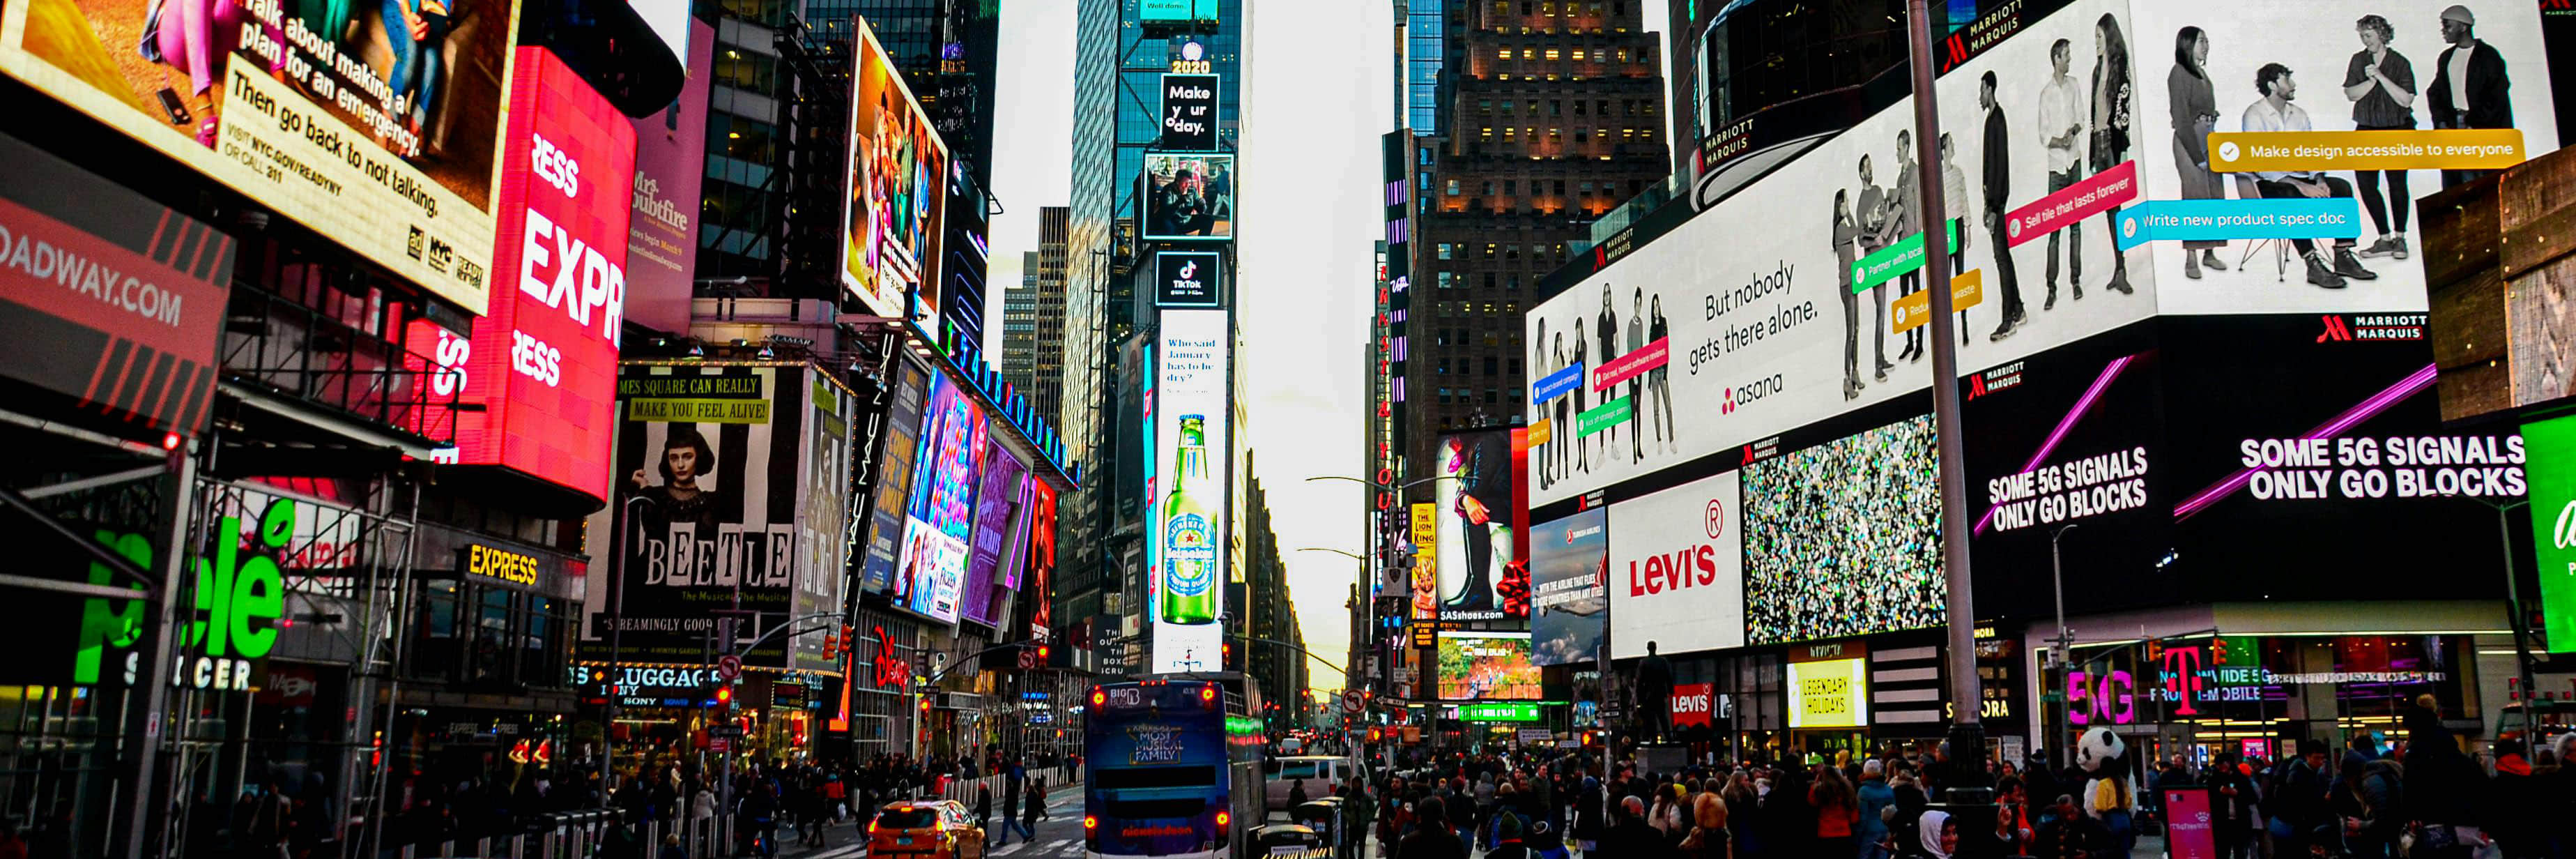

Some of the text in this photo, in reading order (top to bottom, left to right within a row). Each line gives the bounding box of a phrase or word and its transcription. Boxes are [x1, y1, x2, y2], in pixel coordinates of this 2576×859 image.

[1972, 17, 2018, 52] MARQUIS
[285, 17, 406, 115] about making a
[1172, 61, 1211, 74] 2020
[239, 22, 420, 157] plan for an emergency.
[1170, 86, 1210, 99] Make
[233, 70, 438, 217] Then go back to not talking.
[1706, 119, 1754, 151] MARRIOTT
[227, 122, 343, 197] VISIT NYC.GOV/READYNY
[1707, 137, 1747, 166] MARQUIS
[2251, 143, 2513, 161] Make design accessible to everyone
[224, 142, 283, 184] OR CALL 311
[2025, 177, 2130, 229] Sell tile that lasts forever
[2143, 211, 2345, 229] Write new product spec doc
[1607, 227, 1633, 250] MARRIOTT
[431, 236, 452, 264] NYC
[1607, 239, 1631, 261] MARQUIS
[1869, 244, 1924, 277] Partner with local
[1173, 280, 1201, 289] TikTok
[1705, 259, 1796, 322] But nobody
[1954, 284, 1975, 300] waste
[2356, 314, 2428, 328] MARRIOTT
[775, 335, 811, 346] LAMAR
[1168, 339, 1216, 347] Who said
[1689, 297, 1818, 375] gets there alone.
[2356, 328, 2422, 341] MARQUIS
[1167, 351, 1211, 360] January
[1167, 362, 1186, 371] has
[1188, 363, 1199, 371] to
[1986, 360, 2025, 382] MARRIOTT
[644, 377, 758, 397] SQUARE CAN REALLY
[1167, 373, 1193, 383] dry?
[1987, 374, 2022, 393] MARQUIS
[1736, 370, 1783, 409] asana
[634, 400, 767, 419] MAKE YOU FEEL ALIVE!
[858, 411, 880, 486] MAC
[886, 425, 914, 466] COME
[1754, 436, 1779, 452] MARRIOTT
[1754, 445, 1777, 460] MARQUIS
[2240, 434, 2527, 469] SOME 5G SIGNALS
[1988, 446, 2149, 505] SOME 5G SIGNALS
[2249, 466, 2527, 501] ONLY GO BLOCKS
[1992, 478, 2147, 533] ONLY GO BLOCKS
[1415, 522, 1432, 532] LION
[1414, 533, 1434, 542] KING
[470, 544, 538, 586] EXPRESS
[645, 530, 791, 587] BEETLE
[1539, 582, 1549, 594] WITH
[1558, 577, 1573, 590] AIRLINE
[1574, 575, 1584, 587] THAT
[1584, 573, 1596, 585] FLIES
[682, 591, 697, 602] The
[738, 592, 754, 602] The
[1548, 592, 1570, 606] COUNTRIES
[1570, 590, 1581, 600] THAN
[1581, 588, 1590, 599] ANY
[684, 618, 712, 632] GOOD
[1440, 610, 1503, 621] SASshoes.com
[1810, 644, 1843, 658] INVICTA
[1804, 678, 1848, 697] LEGENDARY
[2164, 646, 2201, 715] T
[1110, 689, 1127, 697] BIG
[2068, 670, 2135, 724] 5G
[1807, 698, 1846, 715] HOLIDAYS
[1135, 740, 1184, 750] MUSICAL
[1140, 732, 1171, 741] MOST
[1135, 750, 1176, 761] FAMILY
[1122, 823, 1193, 837] nickelodeon
